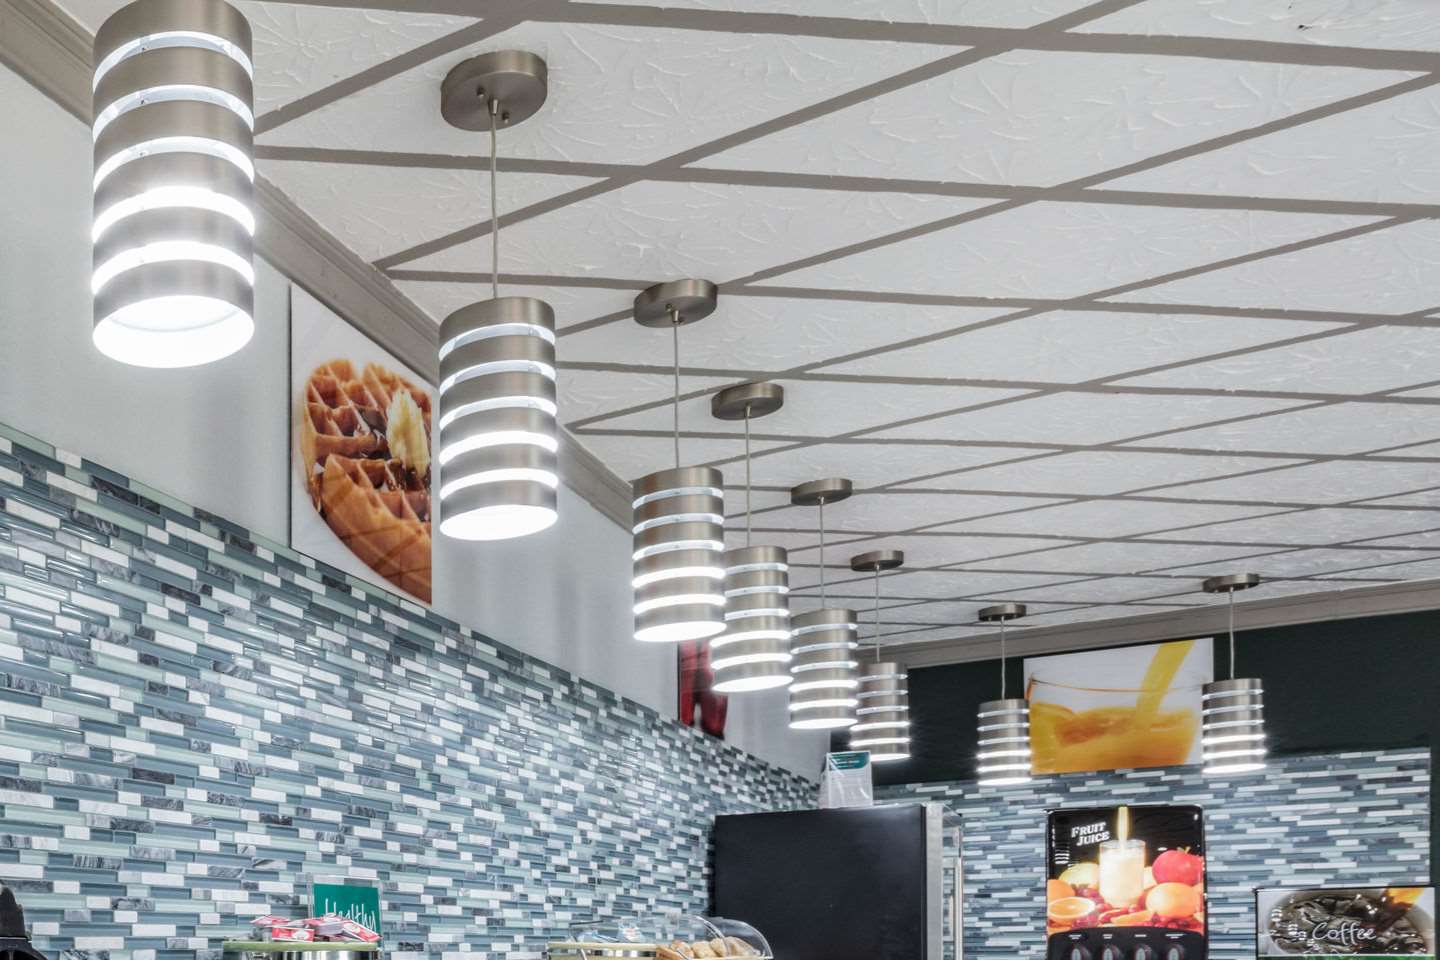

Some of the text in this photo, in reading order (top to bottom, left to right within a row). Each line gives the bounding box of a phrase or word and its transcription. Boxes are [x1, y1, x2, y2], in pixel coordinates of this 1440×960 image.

[1071, 822, 1107, 838] FRUIT
[1076, 831, 1111, 846] JUICE
[1312, 922, 1377, 946] Coffee
